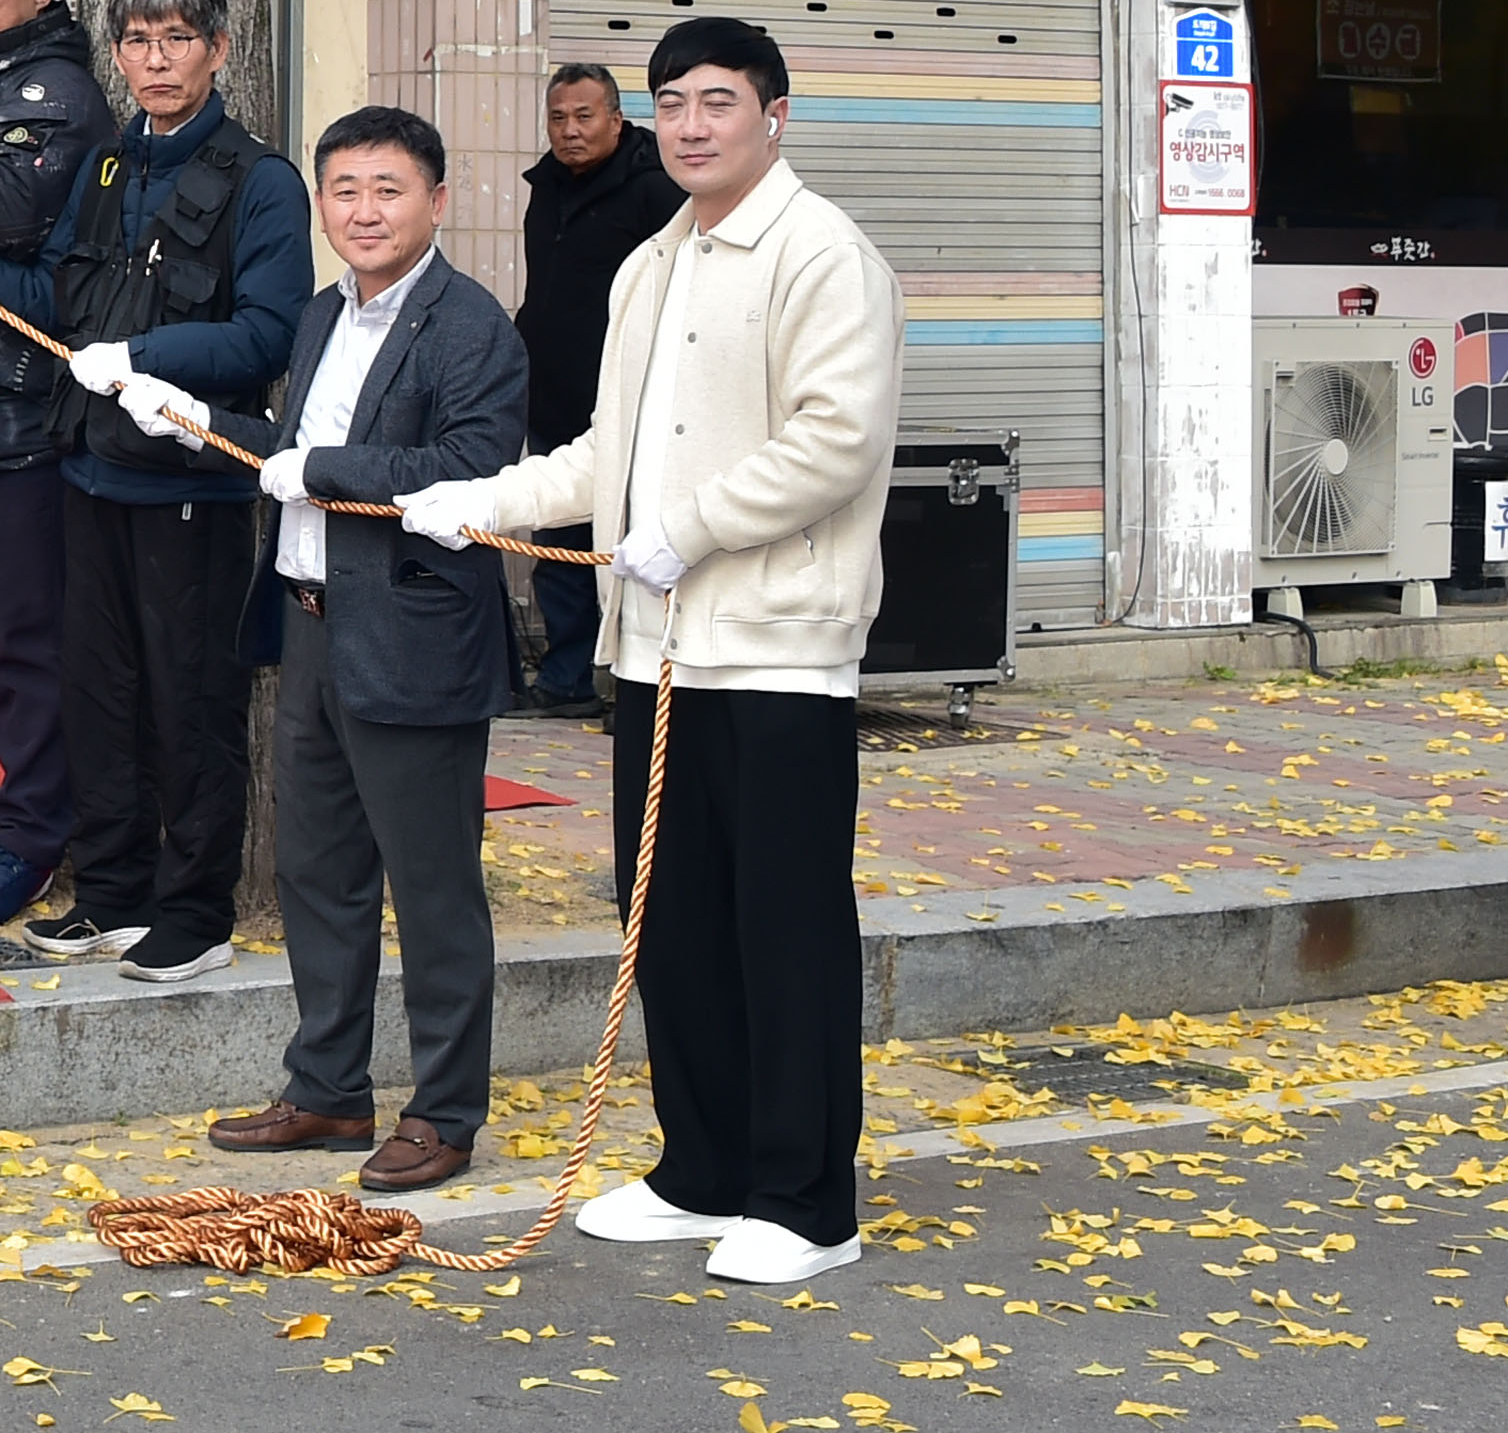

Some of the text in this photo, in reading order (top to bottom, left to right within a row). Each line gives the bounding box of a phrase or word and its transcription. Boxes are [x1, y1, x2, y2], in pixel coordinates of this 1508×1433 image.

[1191, 45, 1219, 72] 42
[1169, 141, 1245, 164] 영상감시구역
[1390, 236, 1430, 261] 푸줏간
[1412, 386, 1434, 407] LG
